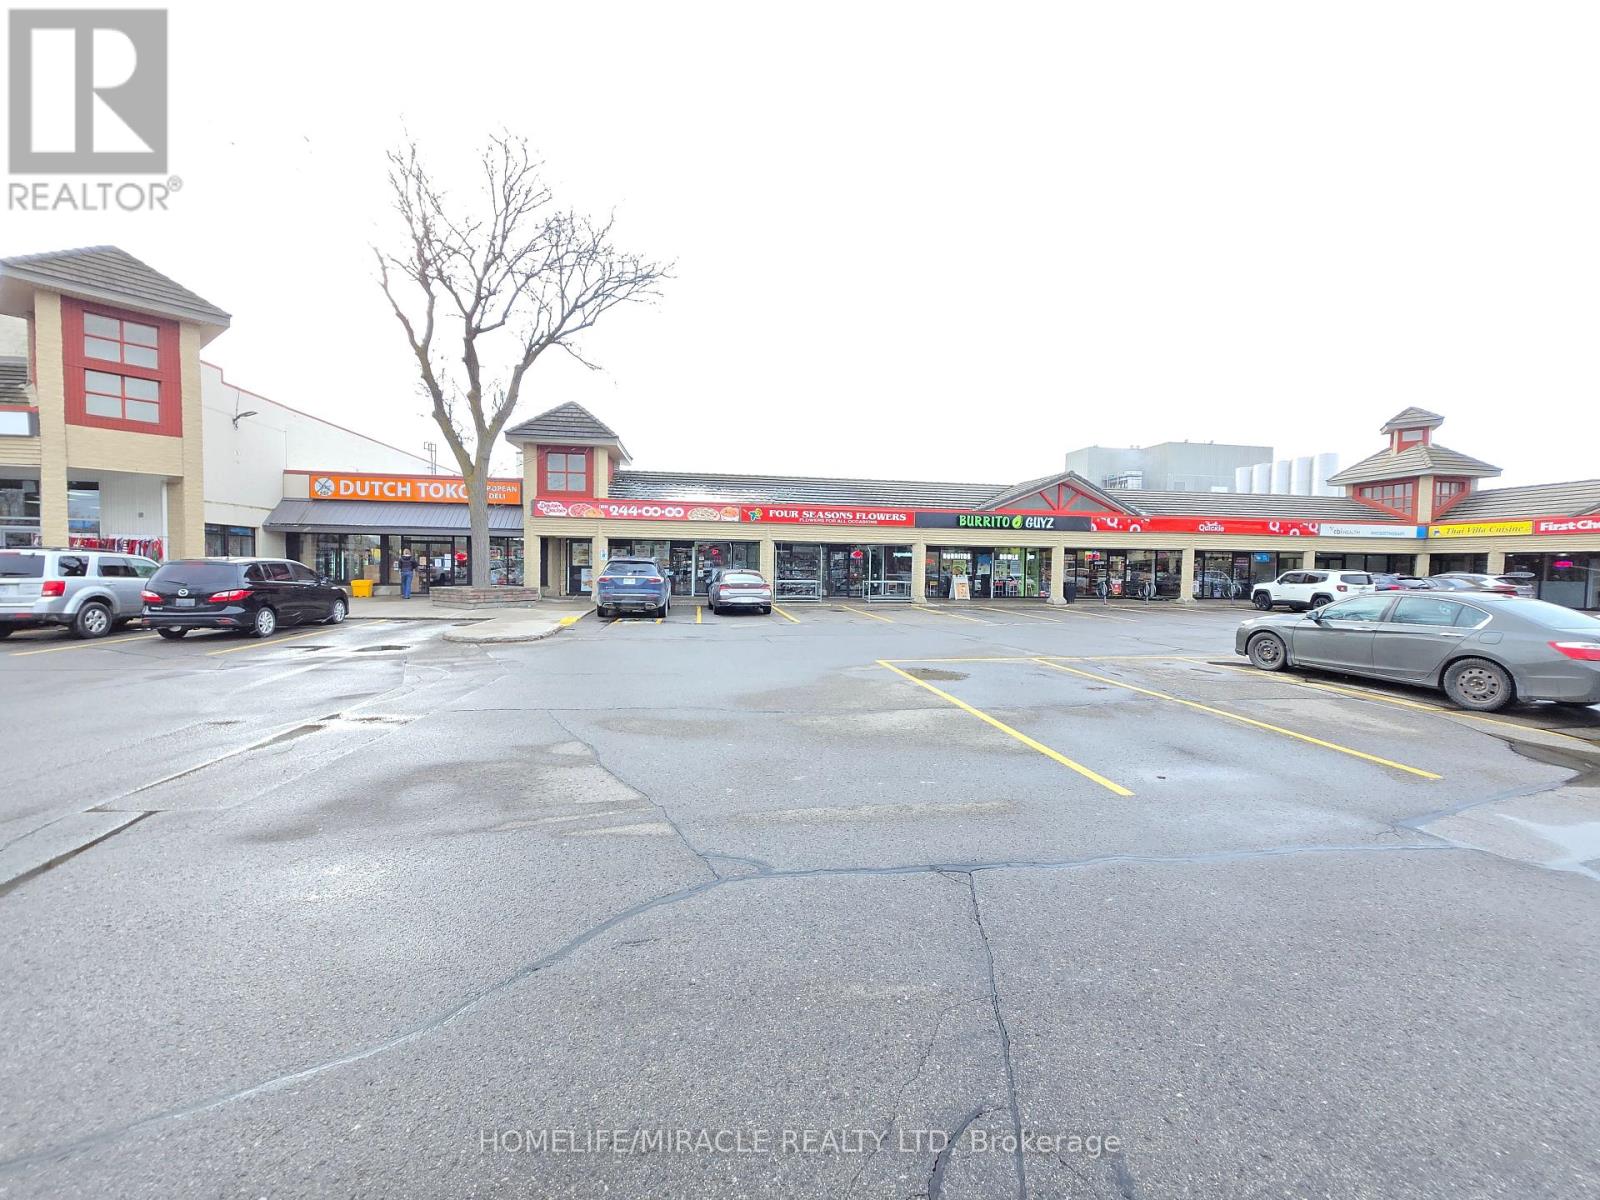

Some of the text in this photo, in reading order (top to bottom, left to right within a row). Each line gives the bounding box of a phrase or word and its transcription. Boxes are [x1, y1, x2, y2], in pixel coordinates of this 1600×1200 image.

[339, 479, 411, 497] DUTCH
[769, 509, 907, 521] FOUR SEASONS FLOWERS
[959, 515, 1055, 528] BURRITO GUYZ
[1540, 521, 1576, 531] First
[1489, 524, 1523, 533] Cuisine
